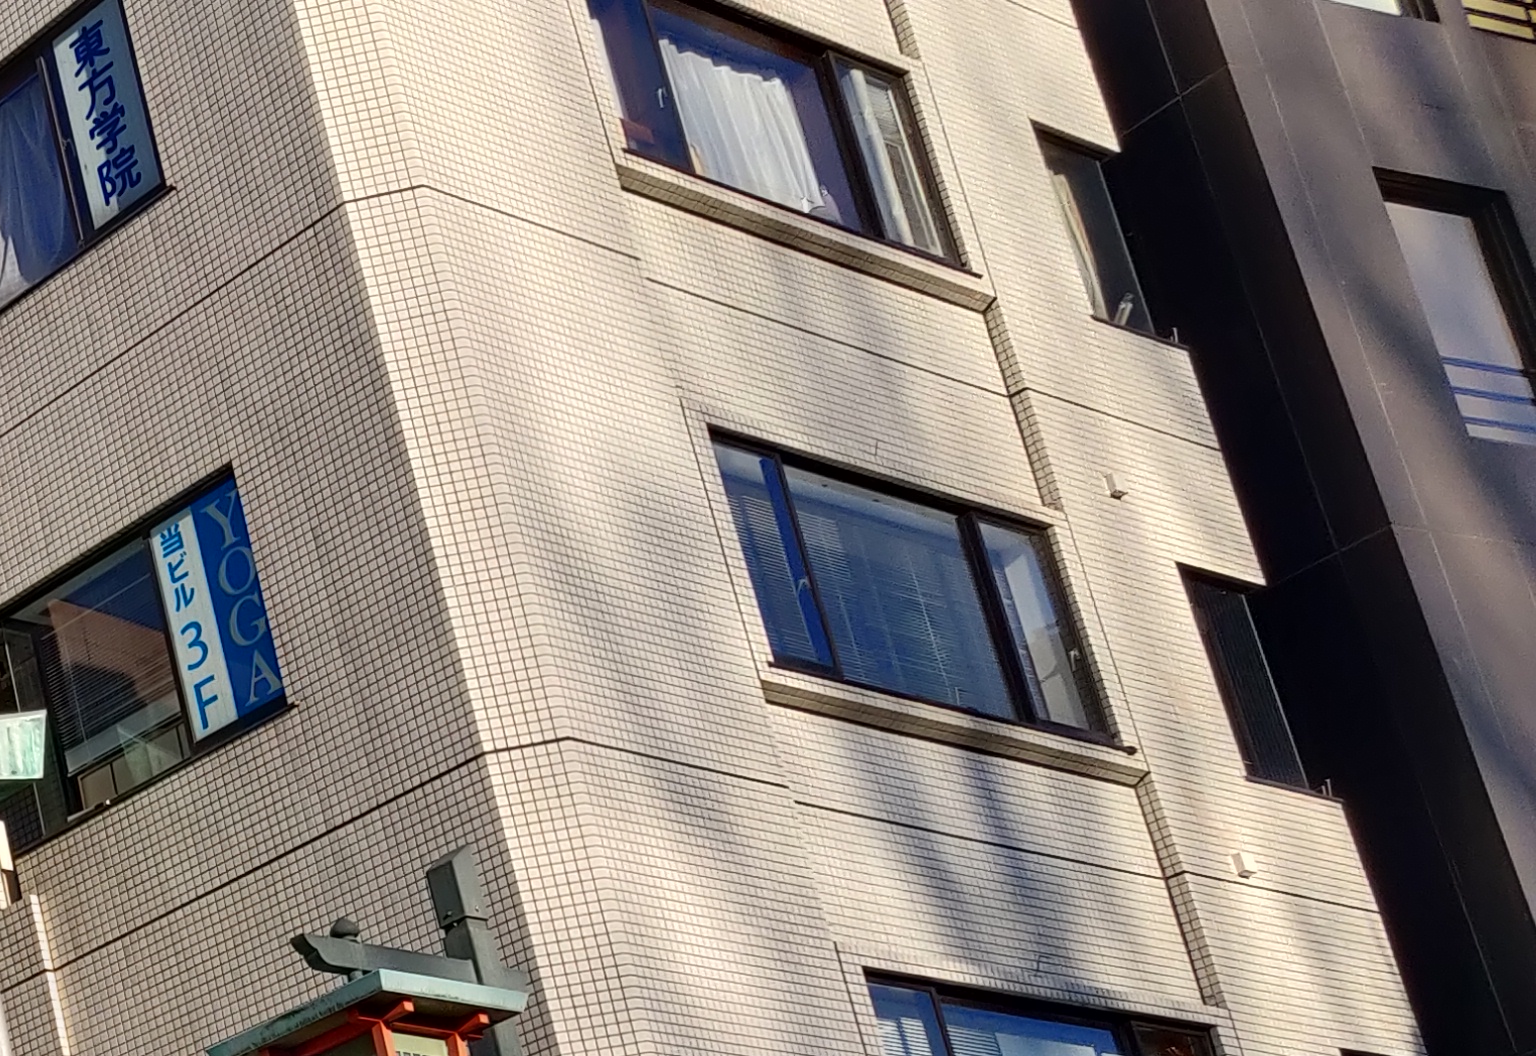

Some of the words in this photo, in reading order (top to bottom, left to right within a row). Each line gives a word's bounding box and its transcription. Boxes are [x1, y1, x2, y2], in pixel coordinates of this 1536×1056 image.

[70, 17, 143, 207] 東方学院
[197, 489, 286, 709] YOGA
